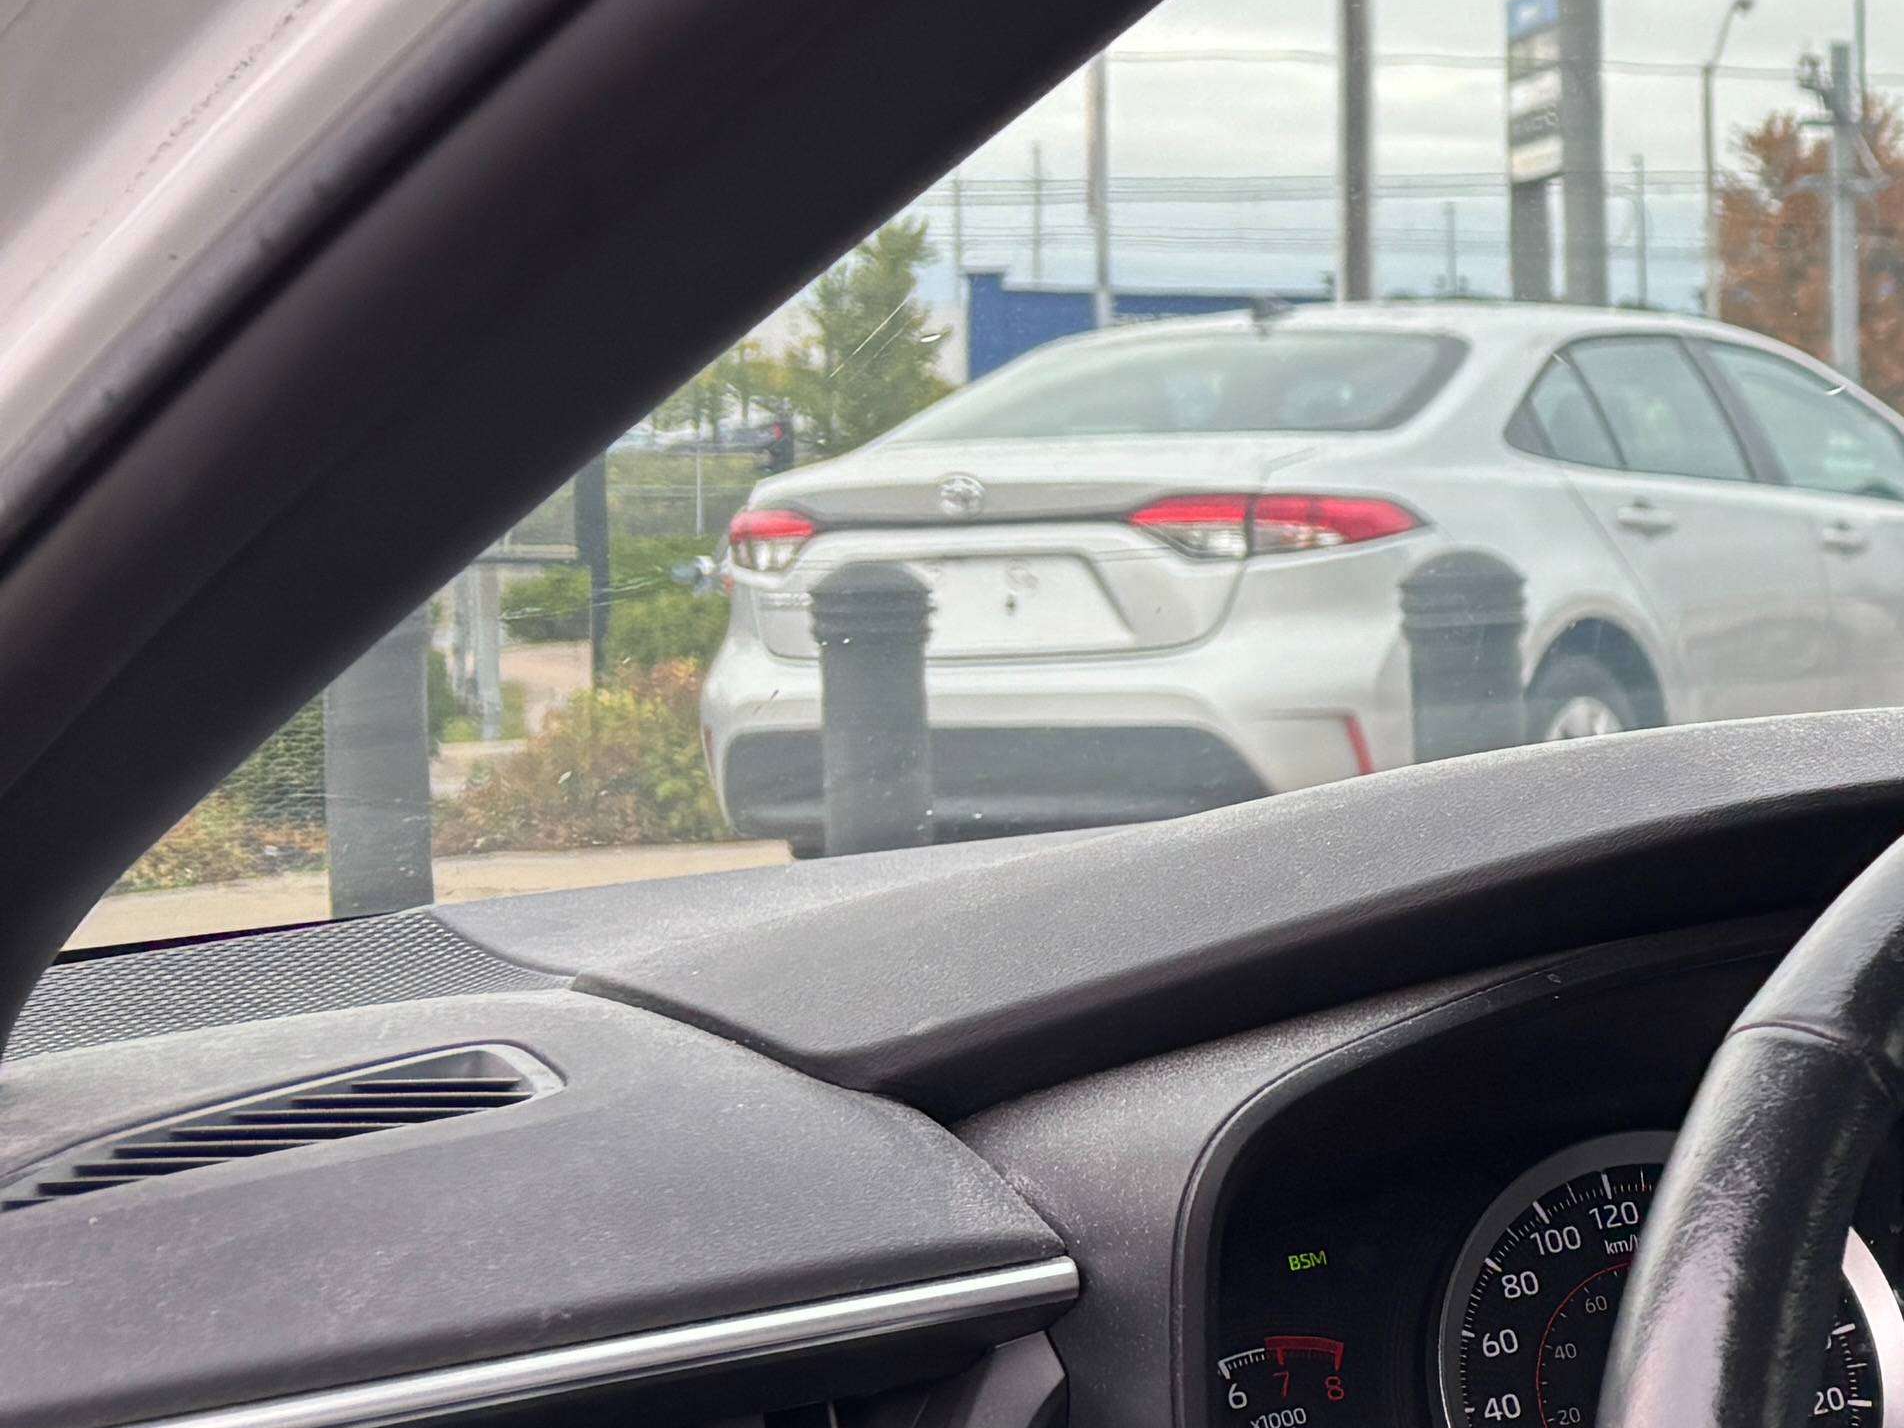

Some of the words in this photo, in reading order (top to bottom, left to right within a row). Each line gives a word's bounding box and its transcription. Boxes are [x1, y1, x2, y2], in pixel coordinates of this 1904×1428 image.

[1588, 1200, 1640, 1230] 120
[1530, 1226, 1582, 1256] 100
[1288, 1249, 1328, 1272] BSM
[1501, 1270, 1540, 1299] 80
[1584, 1294, 1609, 1314] 60
[1482, 1328, 1519, 1358] 60
[1554, 1342, 1578, 1360] 40
[1228, 1382, 1248, 1410] 6
[1272, 1371, 1290, 1398] 7
[1324, 1375, 1345, 1401] 8
[1483, 1393, 1522, 1421] 40
[1811, 1385, 1845, 1415] 20
[1556, 1406, 1581, 1426] 20
